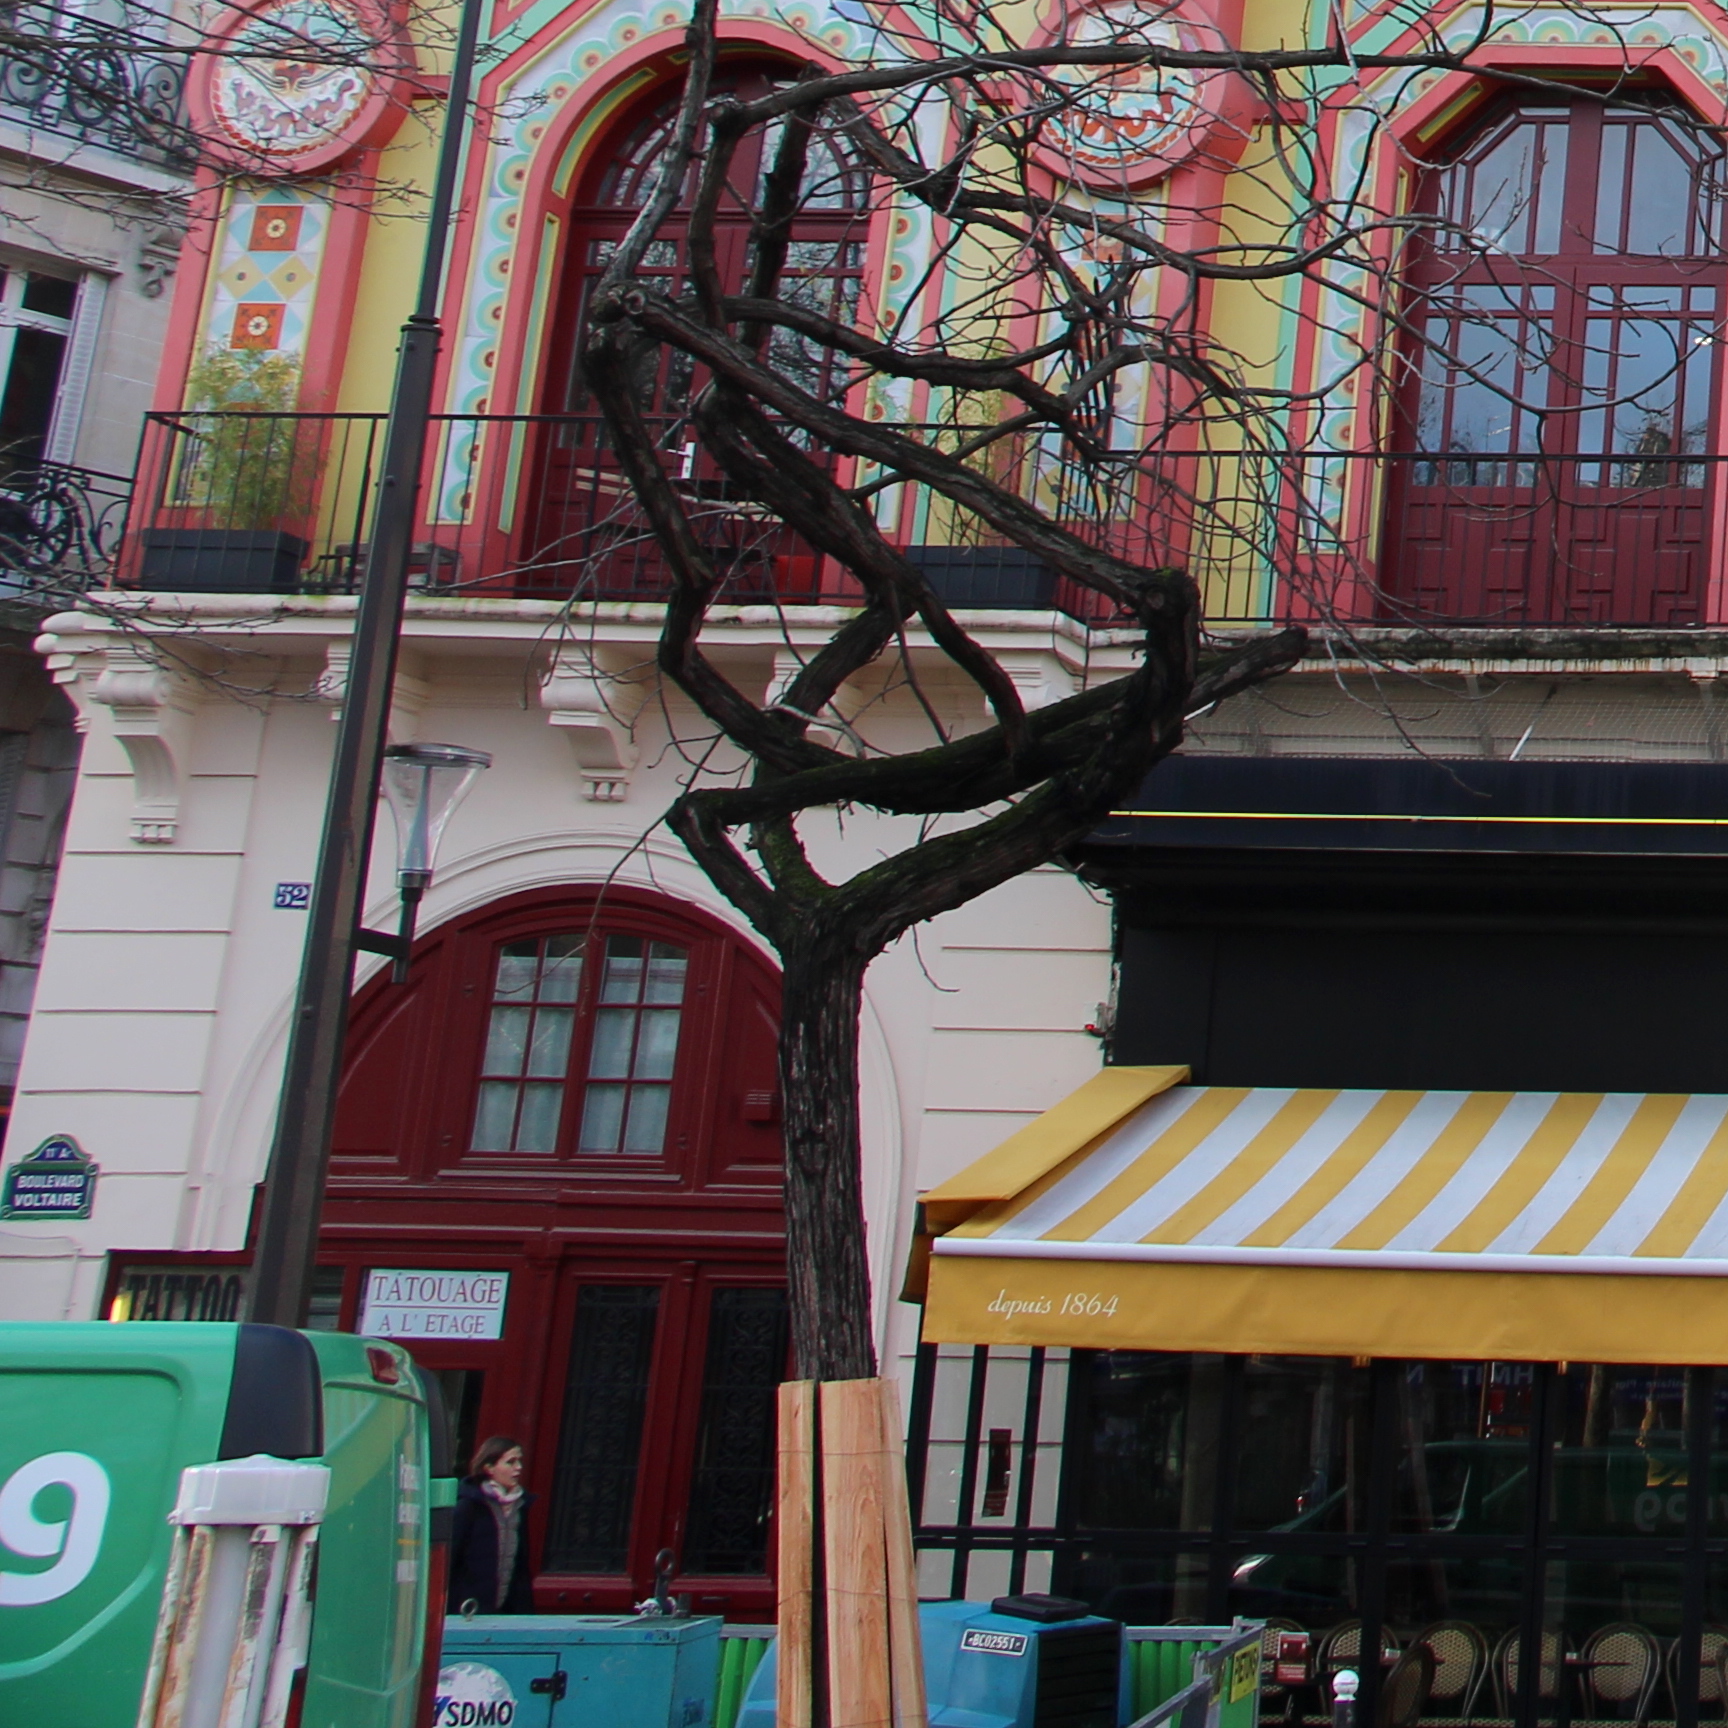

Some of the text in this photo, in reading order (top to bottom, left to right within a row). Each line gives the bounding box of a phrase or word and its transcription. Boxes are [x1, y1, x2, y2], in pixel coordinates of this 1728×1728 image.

[275, 885, 308, 907] 52
[17, 1174, 85, 1189] BOULEVARD
[14, 1192, 84, 1207] VOLTAIRE
[126, 1274, 241, 1321] TATTOO
[372, 1276, 503, 1304] TATOUAGE
[987, 1288, 1120, 1321] depuis 1864
[424, 1314, 486, 1335] ETAGE
[444, 1699, 514, 1727] SDMO
